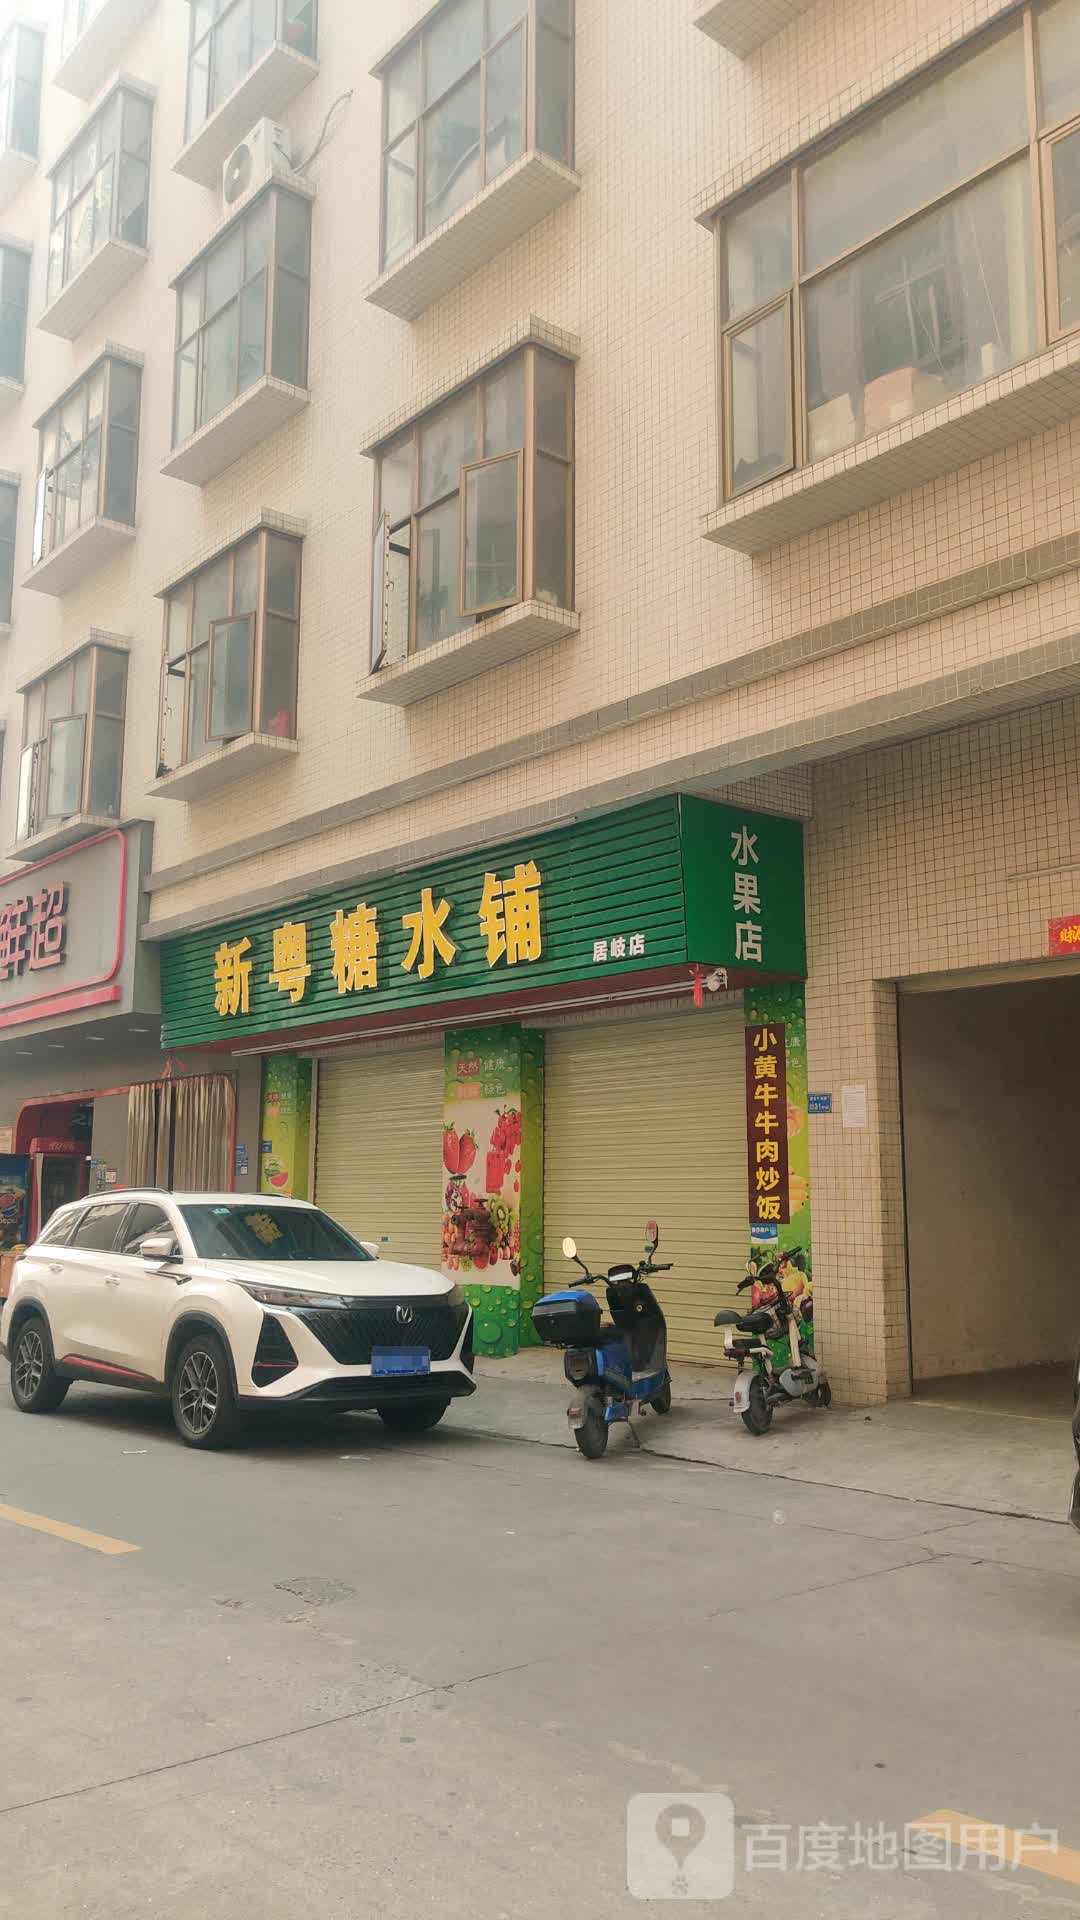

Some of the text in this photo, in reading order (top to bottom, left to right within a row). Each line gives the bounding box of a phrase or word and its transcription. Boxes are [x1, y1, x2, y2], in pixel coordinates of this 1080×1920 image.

[731, 825, 762, 963] 水果店
[214, 861, 541, 1016] 新粤糖水铺
[593, 934, 645, 962] 居岐店
[456, 1058, 506, 1075] 天然 健康
[785, 1057, 803, 1069] 色
[753, 1028, 782, 1220] 小黄牛牛肉炒饭
